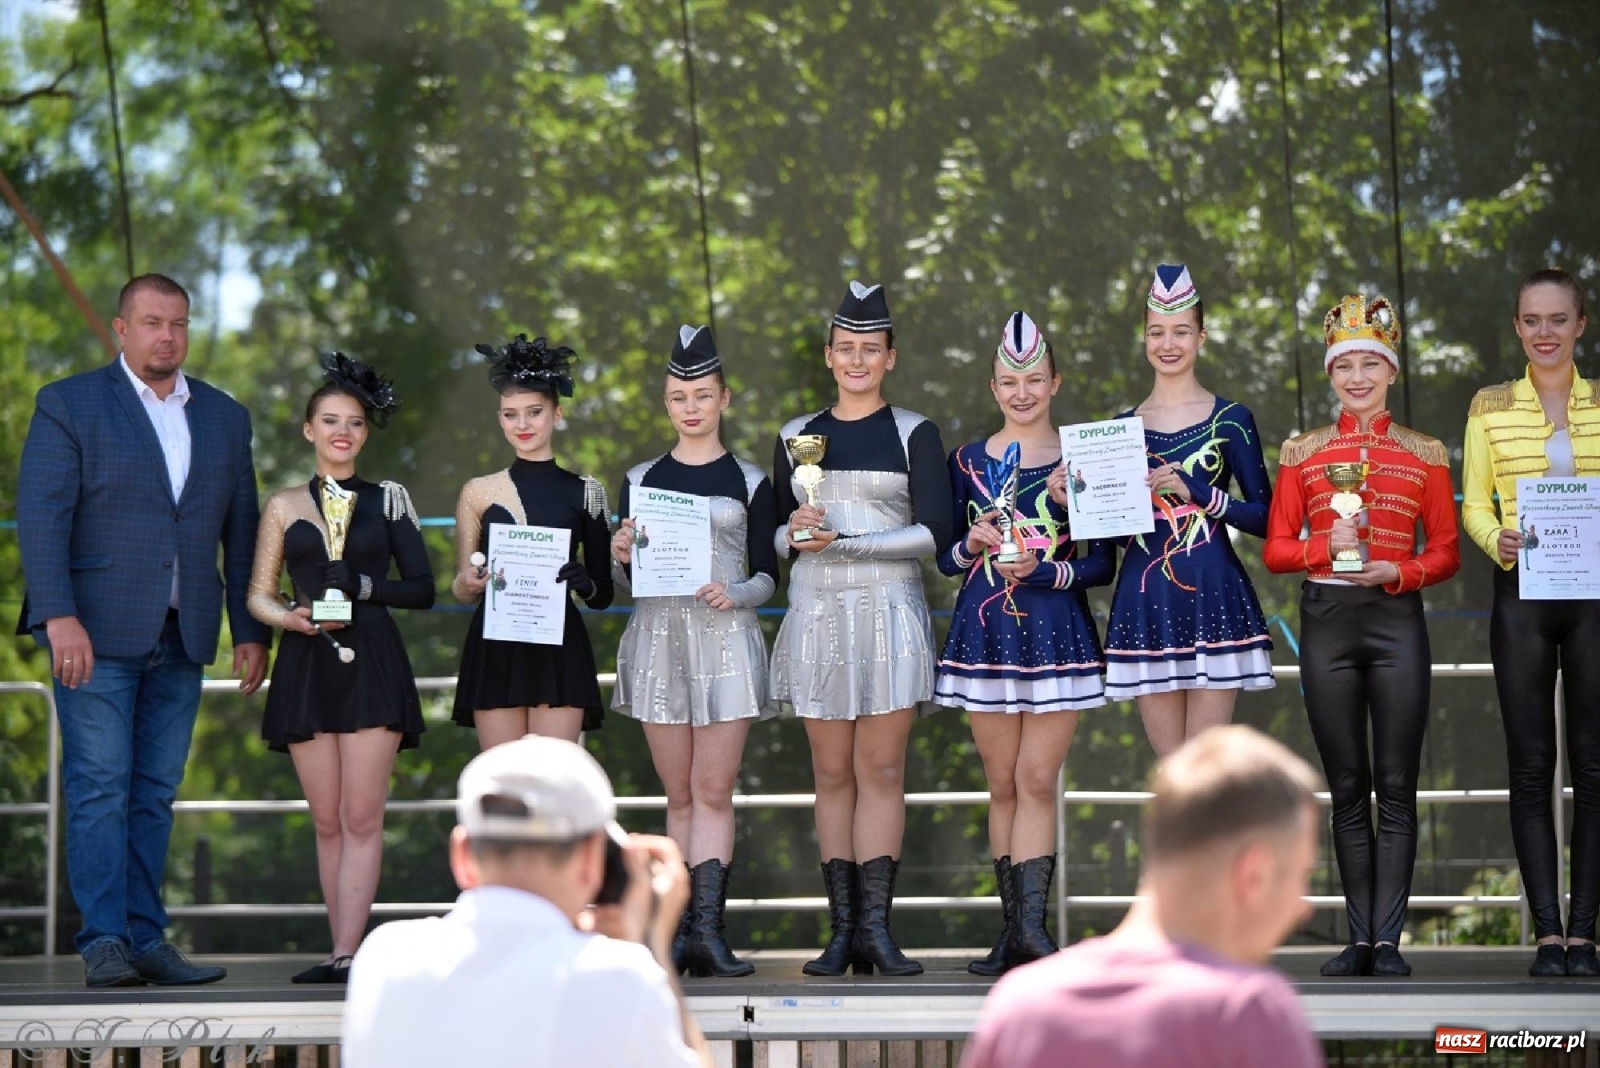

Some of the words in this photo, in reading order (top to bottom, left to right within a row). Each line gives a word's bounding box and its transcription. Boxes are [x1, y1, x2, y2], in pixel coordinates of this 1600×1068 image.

[1079, 424, 1127, 439] DYPLOM
[1537, 483, 1587, 494] DYPLOM
[648, 492, 694, 507] DYPLOM
[508, 530, 554, 543] DYPLOM
[1544, 528, 1569, 536] ZARA
